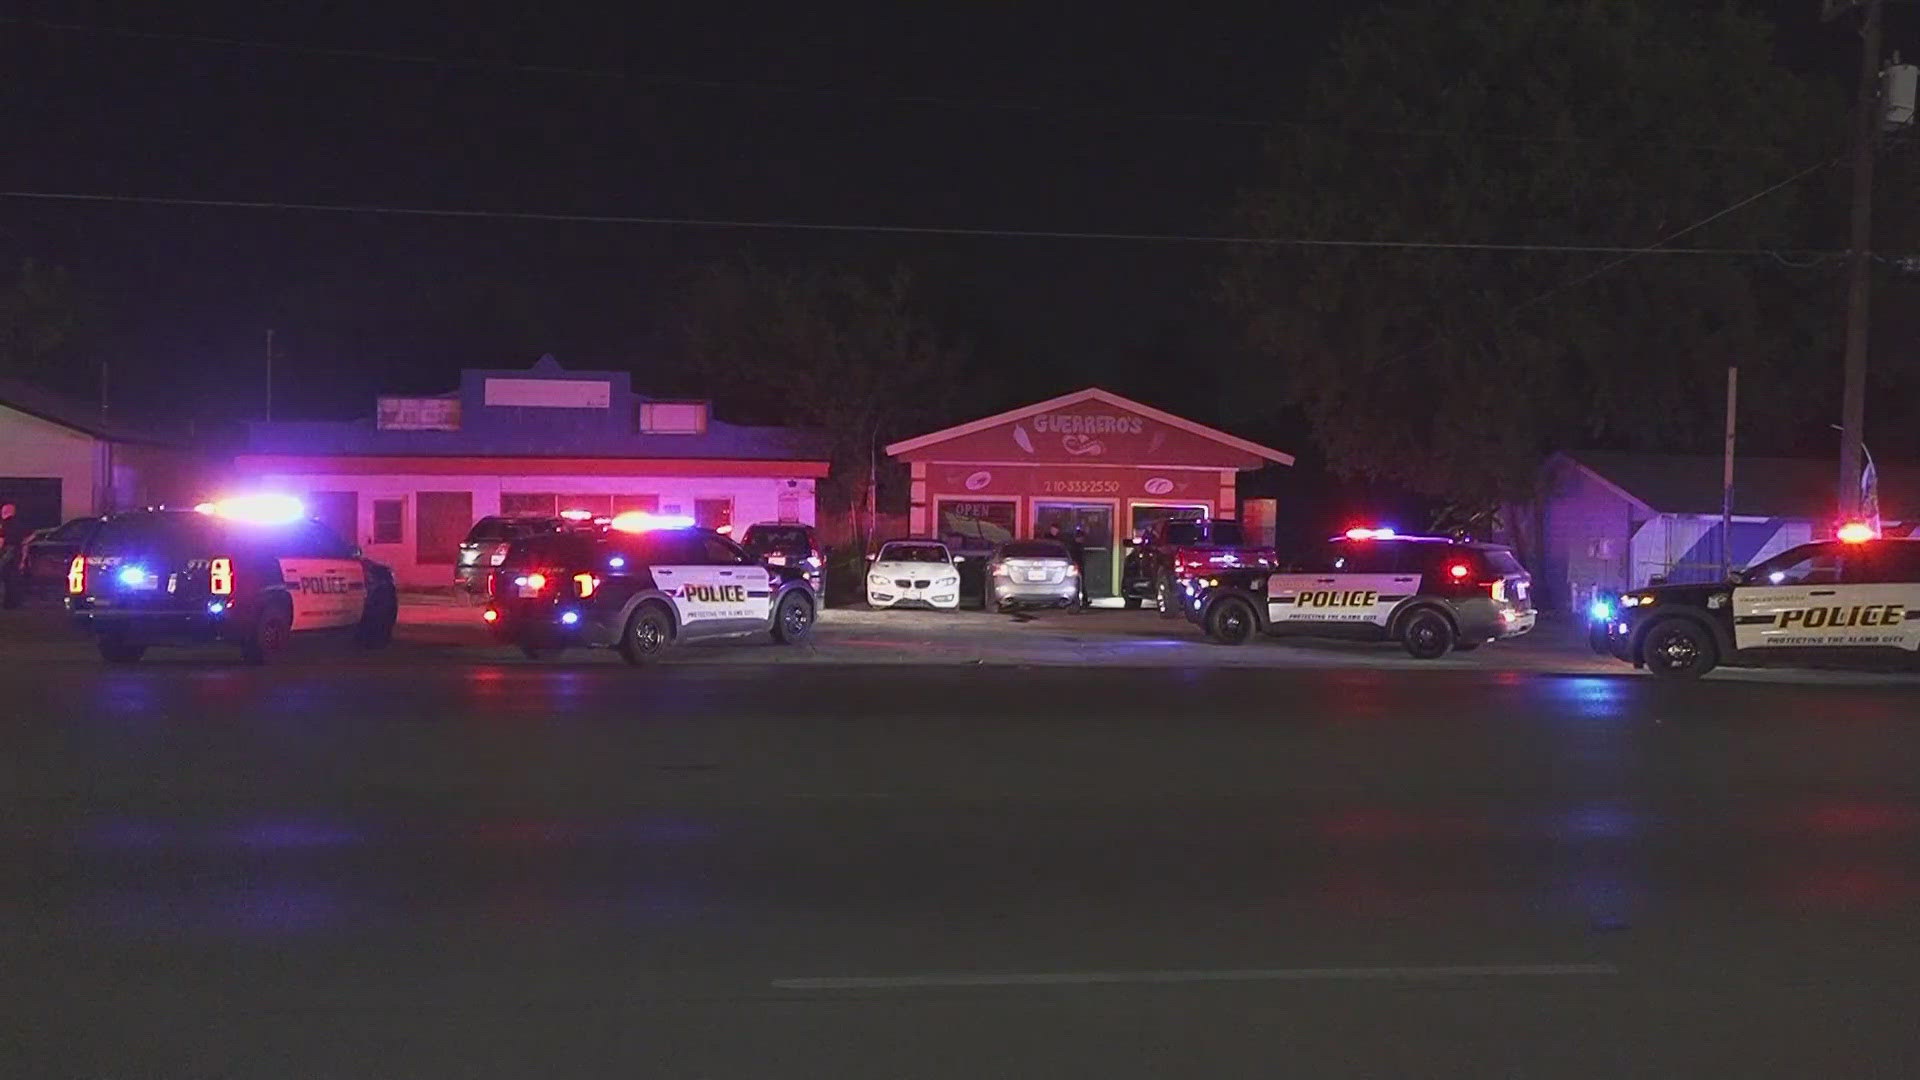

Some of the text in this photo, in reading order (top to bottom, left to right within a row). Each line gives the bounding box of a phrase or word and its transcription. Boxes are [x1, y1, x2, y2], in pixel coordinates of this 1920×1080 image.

[1033, 414, 1143, 434] GUERRERO'S
[956, 503, 989, 517] OPEN
[301, 576, 347, 594] POLICE
[684, 584, 745, 602] POLICE
[1297, 591, 1377, 607] POLICE
[1779, 603, 1905, 629] POLICE
[1767, 635, 1905, 644] PROTECTING THE ALAMO CITY
